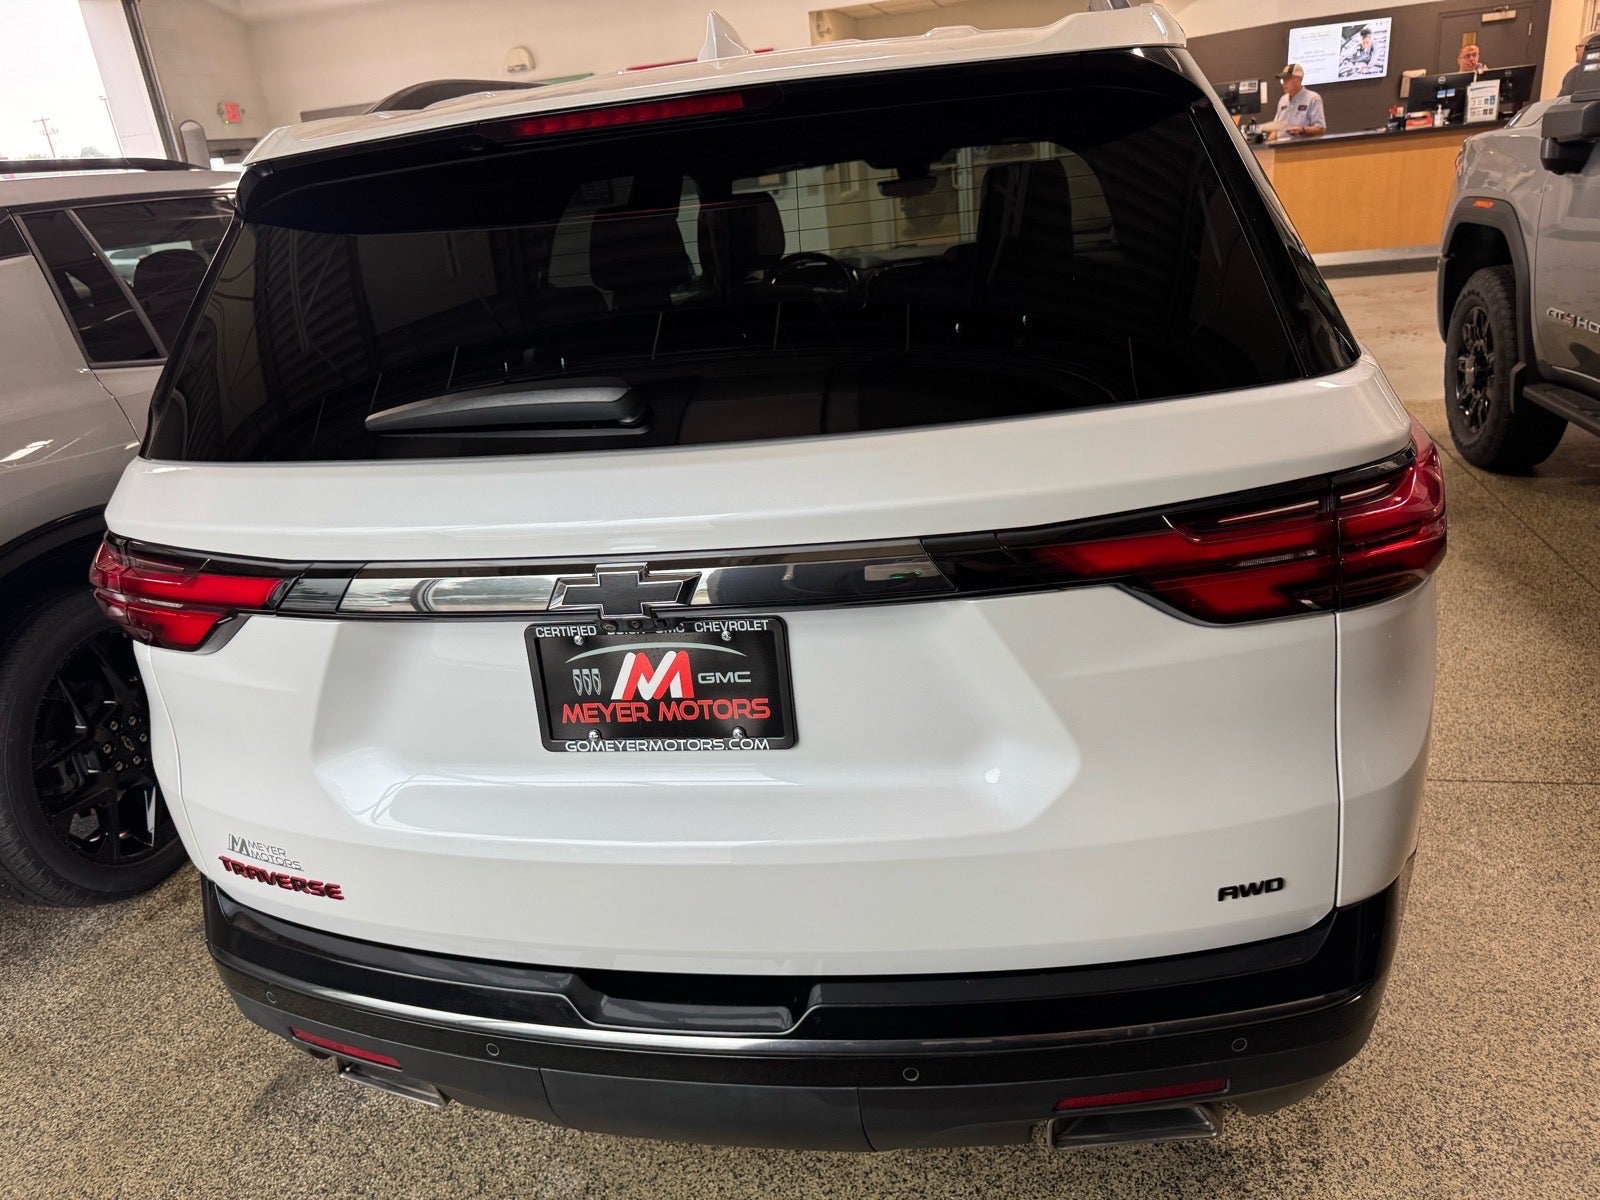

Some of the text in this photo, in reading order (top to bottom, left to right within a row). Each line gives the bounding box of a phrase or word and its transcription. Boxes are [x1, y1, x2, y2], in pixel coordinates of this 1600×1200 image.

[535, 625, 597, 638] CERTIFIED
[694, 619, 769, 633] CHEVROLET
[697, 671, 751, 684] GMC
[562, 698, 771, 724] MEYER MOTORS
[565, 738, 770, 752] GOMEYERMOTORS.COM
[248, 839, 287, 857] MEYER
[250, 850, 304, 872] MOTORS
[218, 855, 345, 900] TRAVERSE
[1218, 877, 1285, 902] AWD
